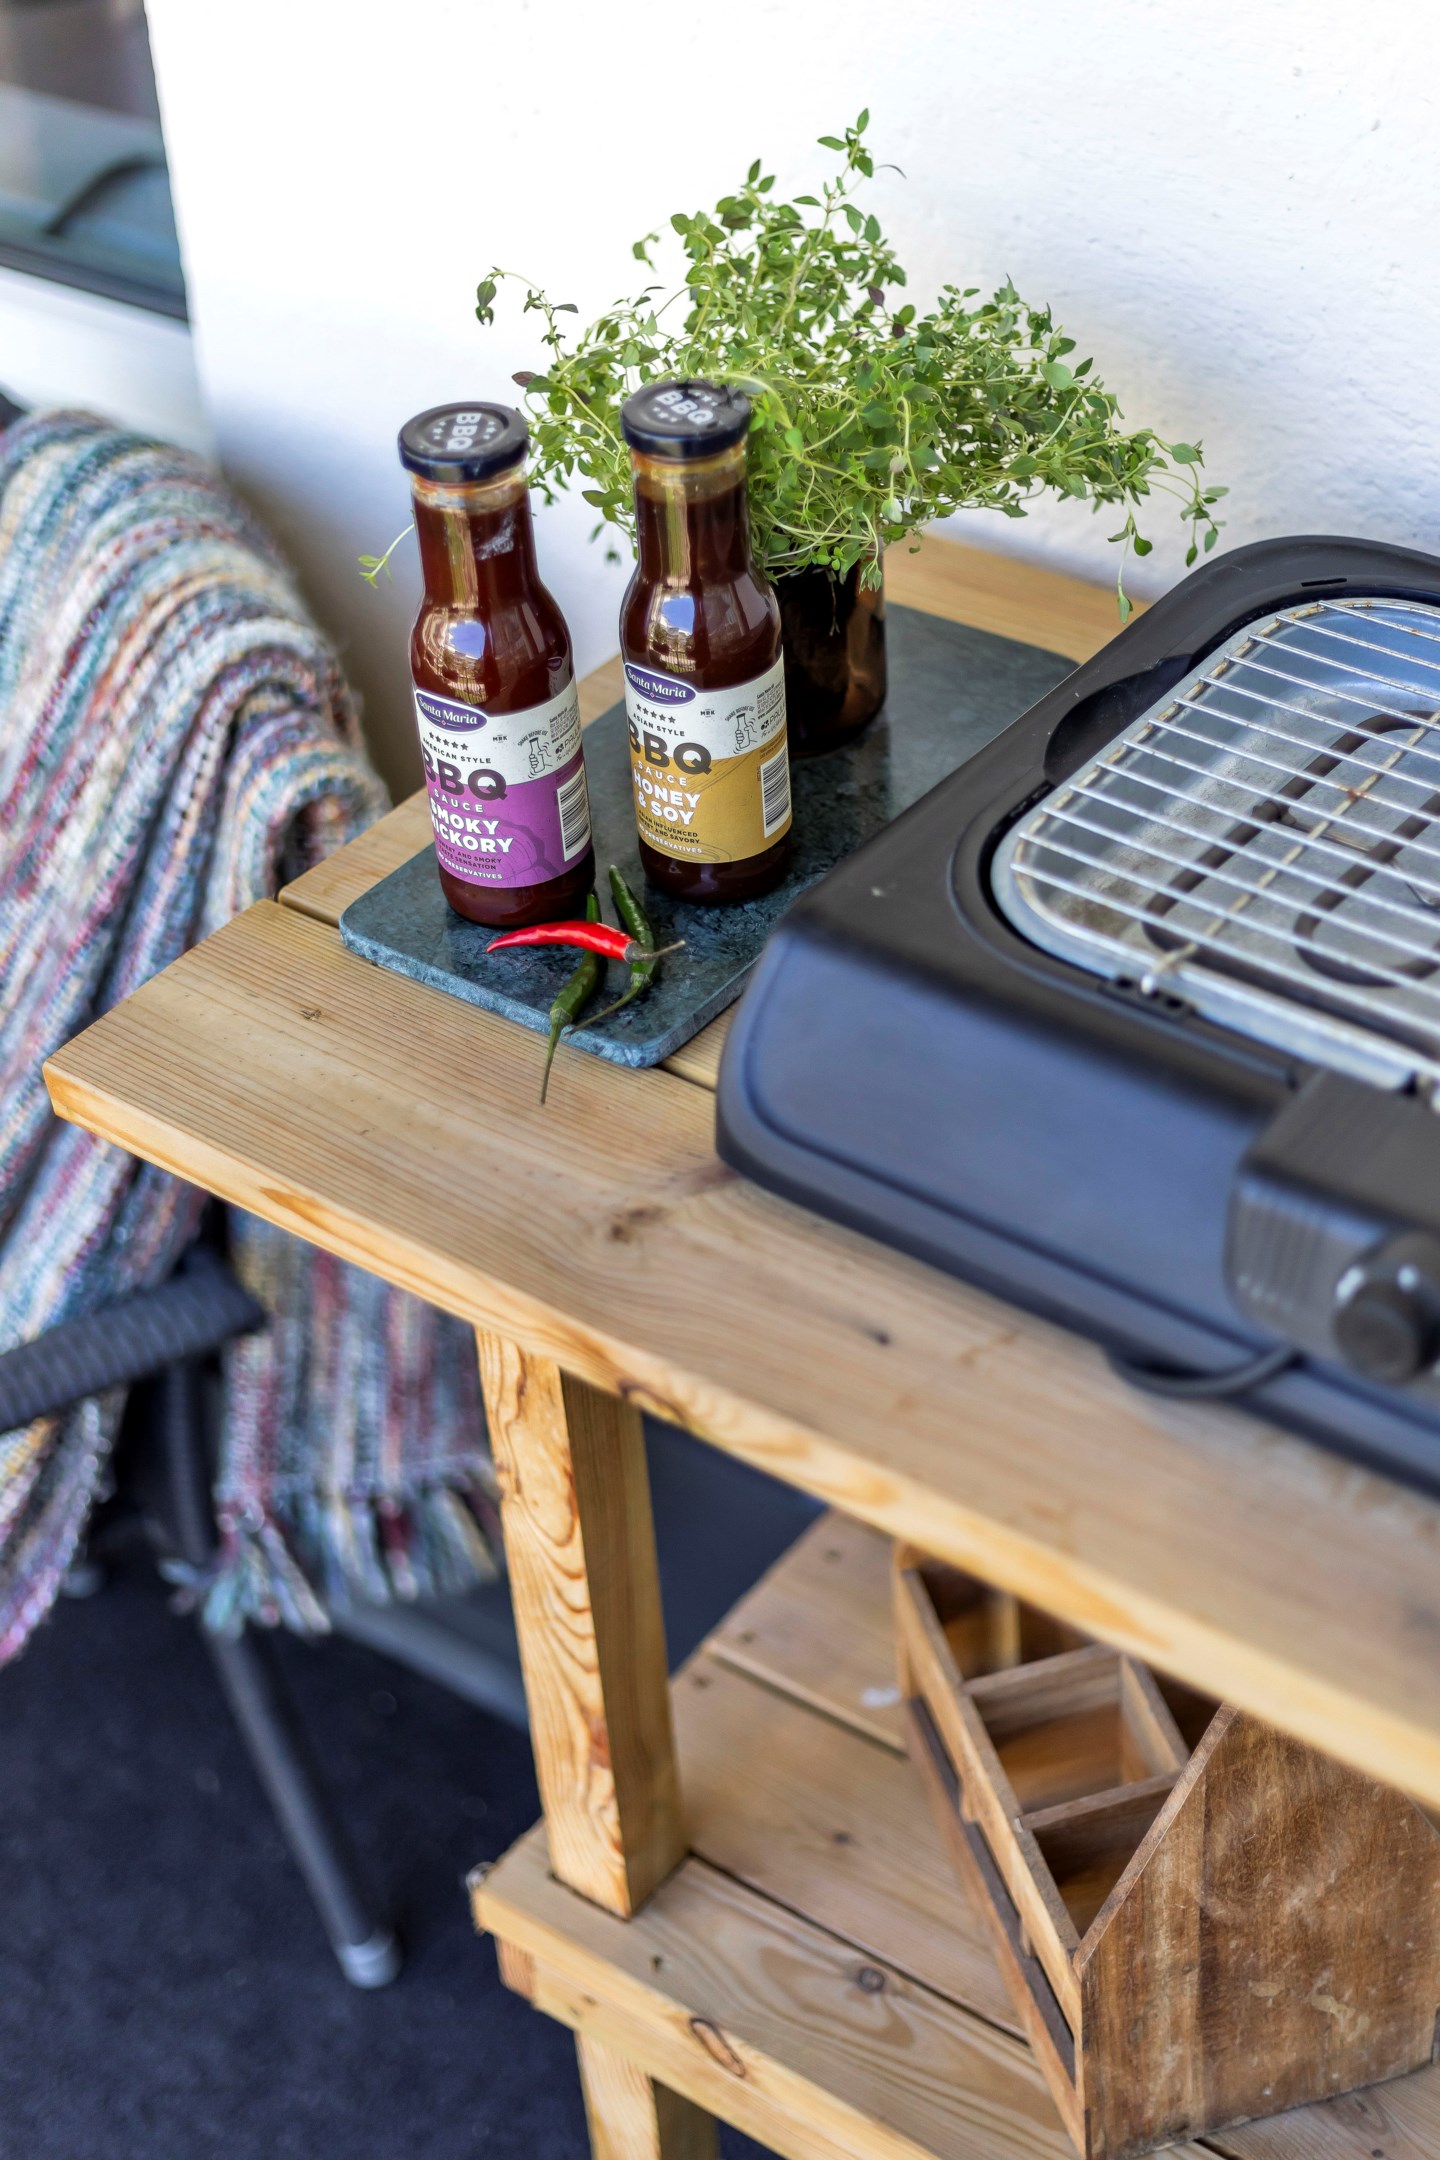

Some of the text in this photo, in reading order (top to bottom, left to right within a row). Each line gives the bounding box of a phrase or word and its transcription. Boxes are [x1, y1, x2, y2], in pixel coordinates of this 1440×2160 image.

[655, 390, 713, 425] BBQ
[446, 412, 482, 450] BBQ
[627, 668, 687, 698] Santa Maria
[418, 697, 478, 725] Santa Maria
[633, 713, 685, 737] ASIAN STYLE
[423, 737, 491, 764] AMERICAN STYLE
[628, 715, 712, 775] BBQ
[421, 743, 508, 801] BBQ
[637, 760, 687, 786] SAUCE
[434, 788, 484, 813] SAUCE
[633, 767, 700, 808] HONEY
[430, 797, 499, 835] SMOKY
[638, 790, 694, 825] & SOY
[645, 829, 703, 853] PRESERVATIVES
[653, 820, 698, 838] INFLUENCED
[655, 828, 669, 837] AND
[669, 833, 700, 844] SAVORY
[444, 857, 503, 879] PRESERVATIVES
[454, 856, 496, 870] SENSATION
[457, 851, 472, 860] AND
[474, 856, 502, 864] SMOKY
